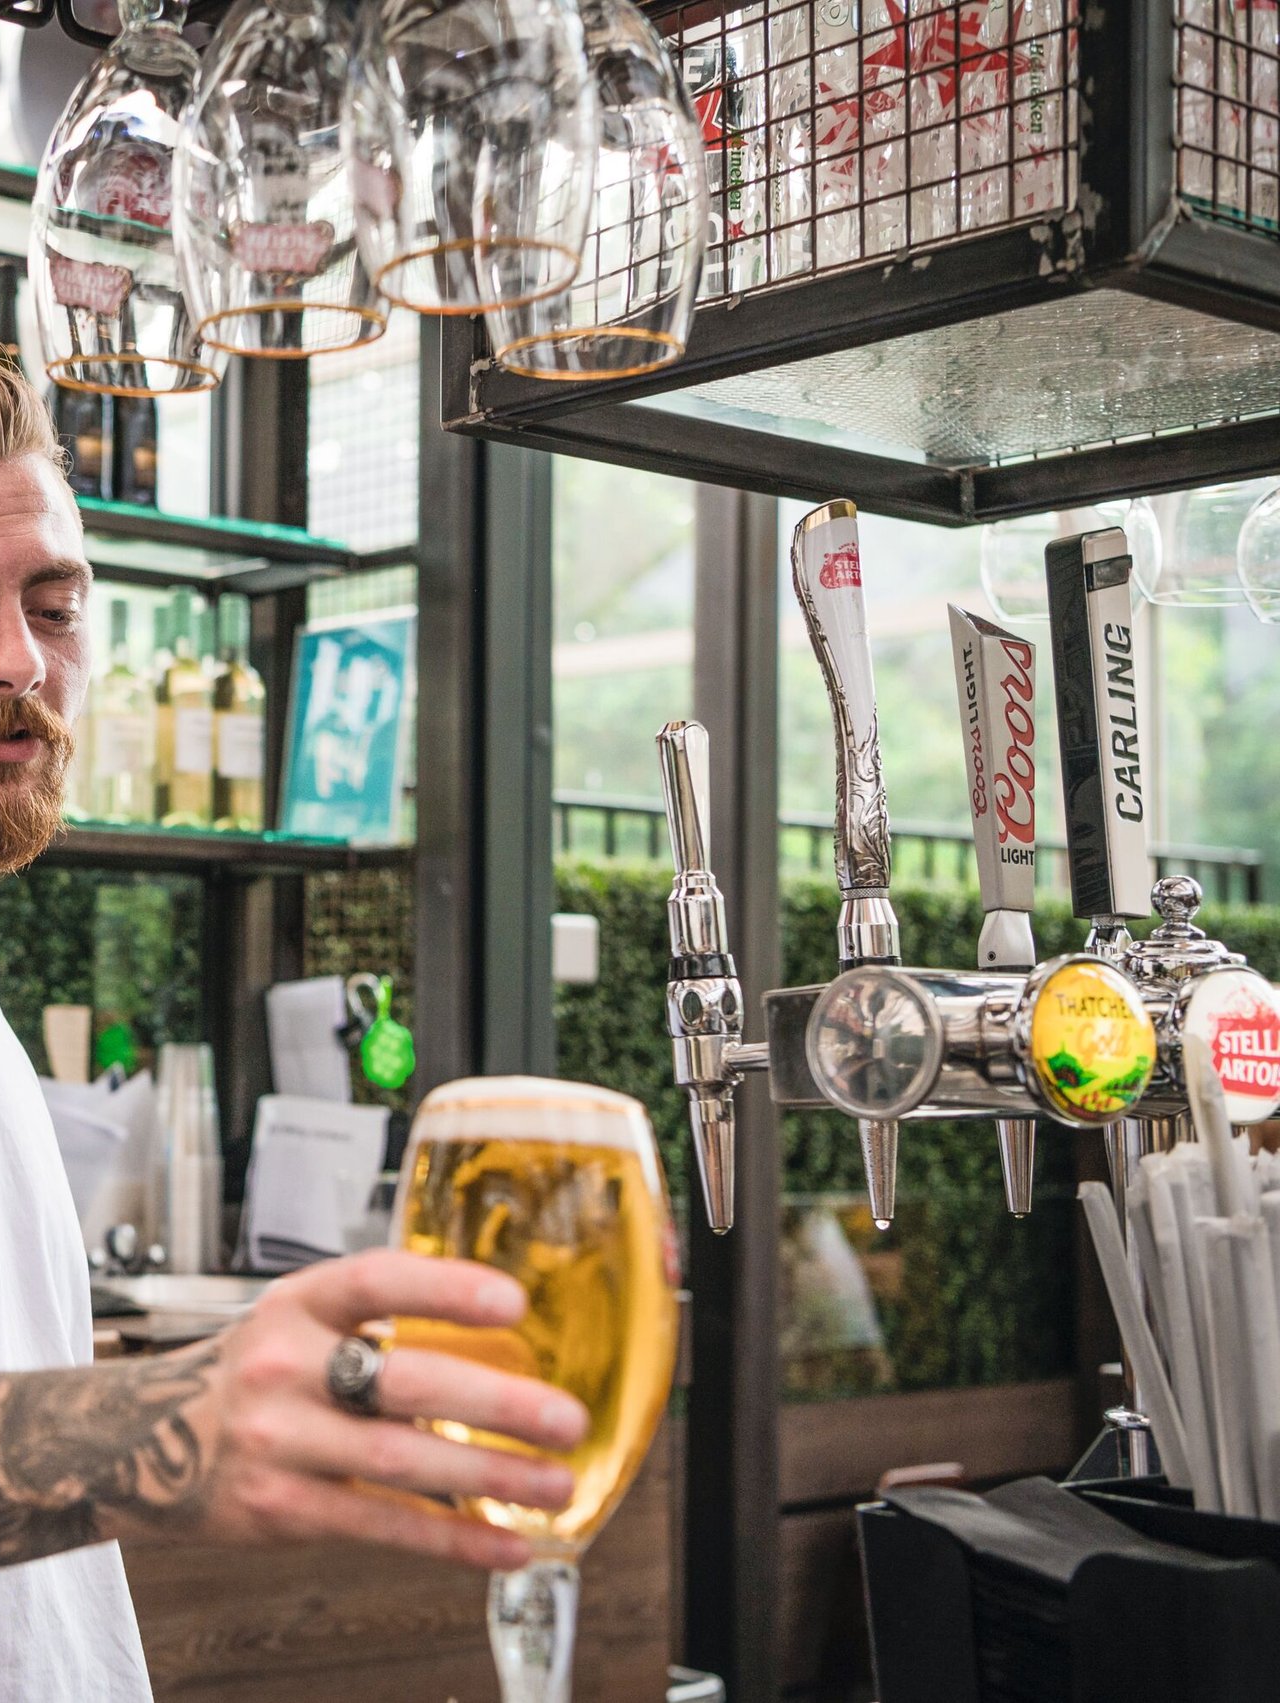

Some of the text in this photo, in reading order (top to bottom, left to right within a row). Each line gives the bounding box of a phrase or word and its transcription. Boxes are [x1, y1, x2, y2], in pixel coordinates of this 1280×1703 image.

[993, 639, 1035, 844] Coors
[1103, 622, 1144, 824] CARLING
[970, 724, 988, 819] Coors
[1000, 846, 1035, 867] LIGHT
[1218, 1030, 1280, 1060] STELL
